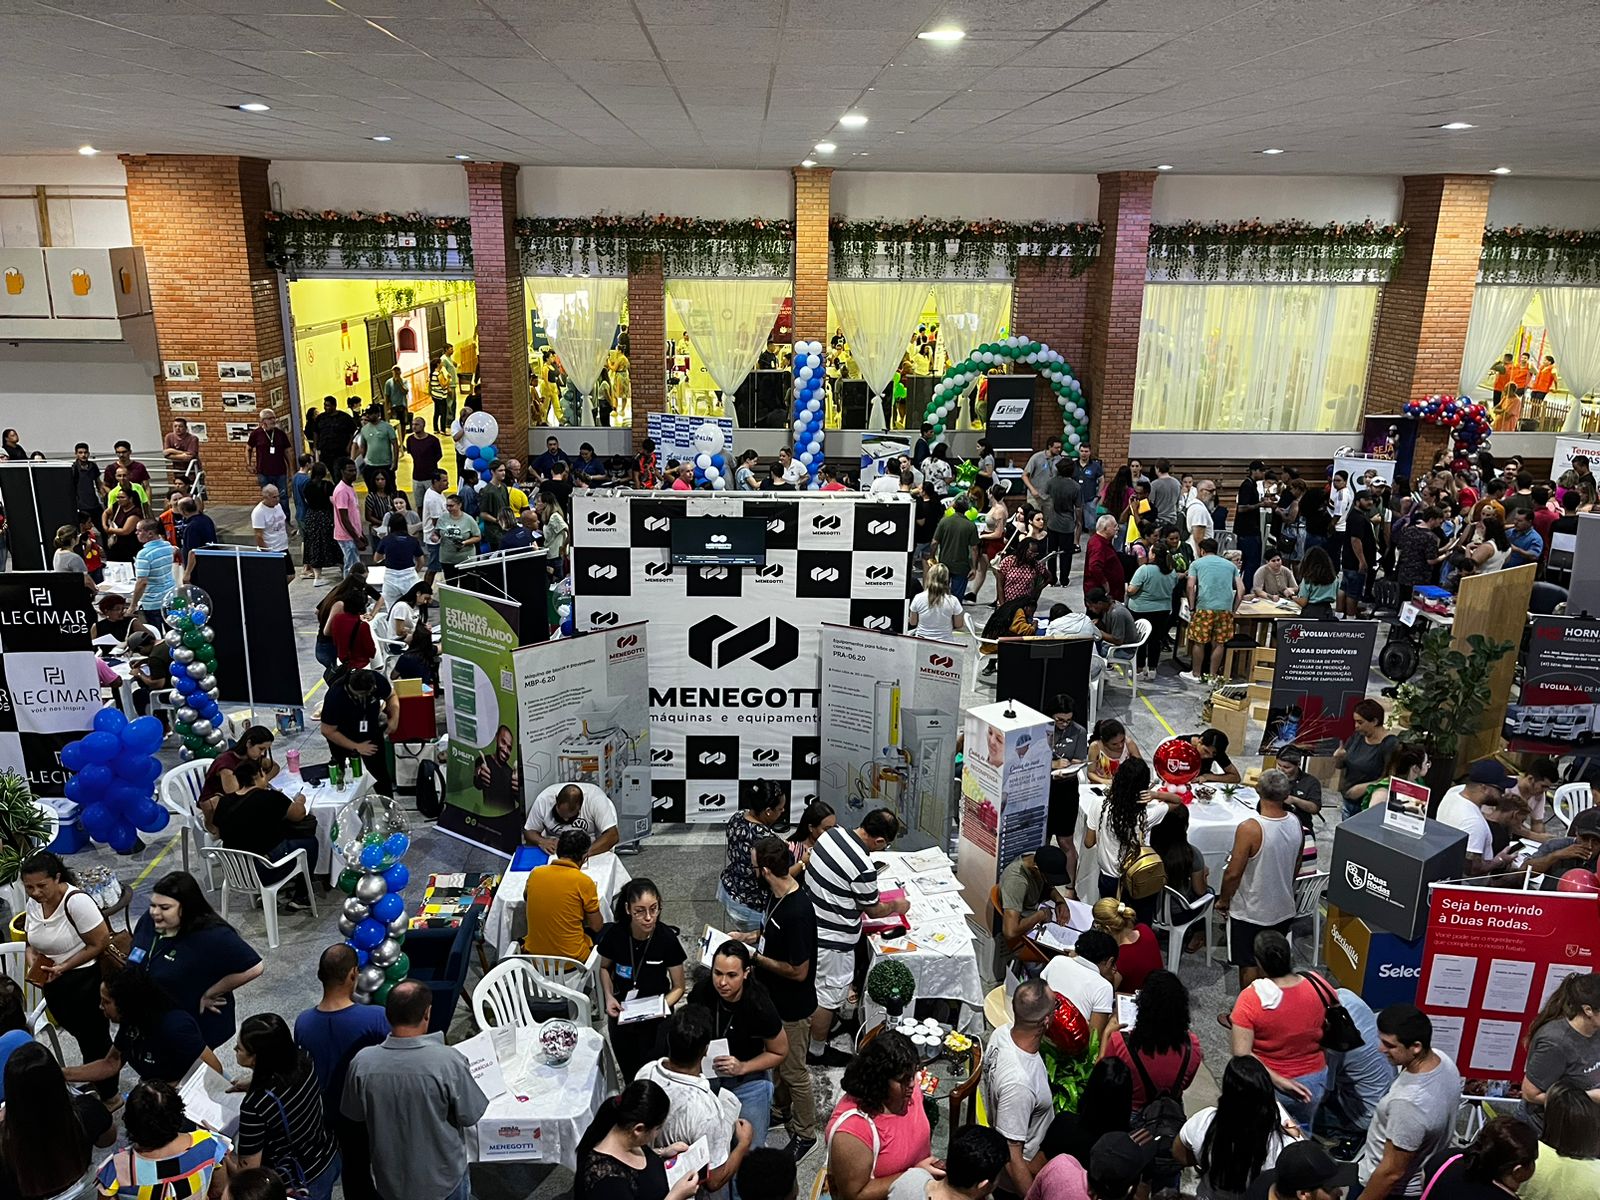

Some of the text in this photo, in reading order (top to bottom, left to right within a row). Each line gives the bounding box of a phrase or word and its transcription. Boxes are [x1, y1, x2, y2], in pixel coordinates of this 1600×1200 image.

[1373, 443, 1394, 454] SEJA
[1571, 446, 1600, 456] Temos
[1566, 454, 1600, 465] VAS
[1, 610, 87, 625] LECIMAR
[445, 607, 488, 628] ESTAMOS
[60, 624, 89, 634] KIDS
[446, 616, 513, 644] CONTRATANDO
[1565, 627, 1600, 638] HORN
[609, 647, 645, 660] MENEGOTTI
[833, 650, 866, 662] PRA-06.20
[1316, 647, 1357, 655] DISPONÍVEIS
[920, 666, 961, 679] MENEGOTTI
[1540, 682, 1572, 691] EVOLUA.
[13, 688, 101, 706] LECIMAR
[649, 711, 713, 724] máquinas
[721, 714, 729, 723] e
[1367, 872, 1388, 887] Duas
[1366, 880, 1391, 896] Rodas
[1442, 898, 1544, 916] Seja bem-vindo
[1439, 913, 1533, 931] à Duas Rodas.
[489, 1143, 534, 1151] MENEGOTTI
